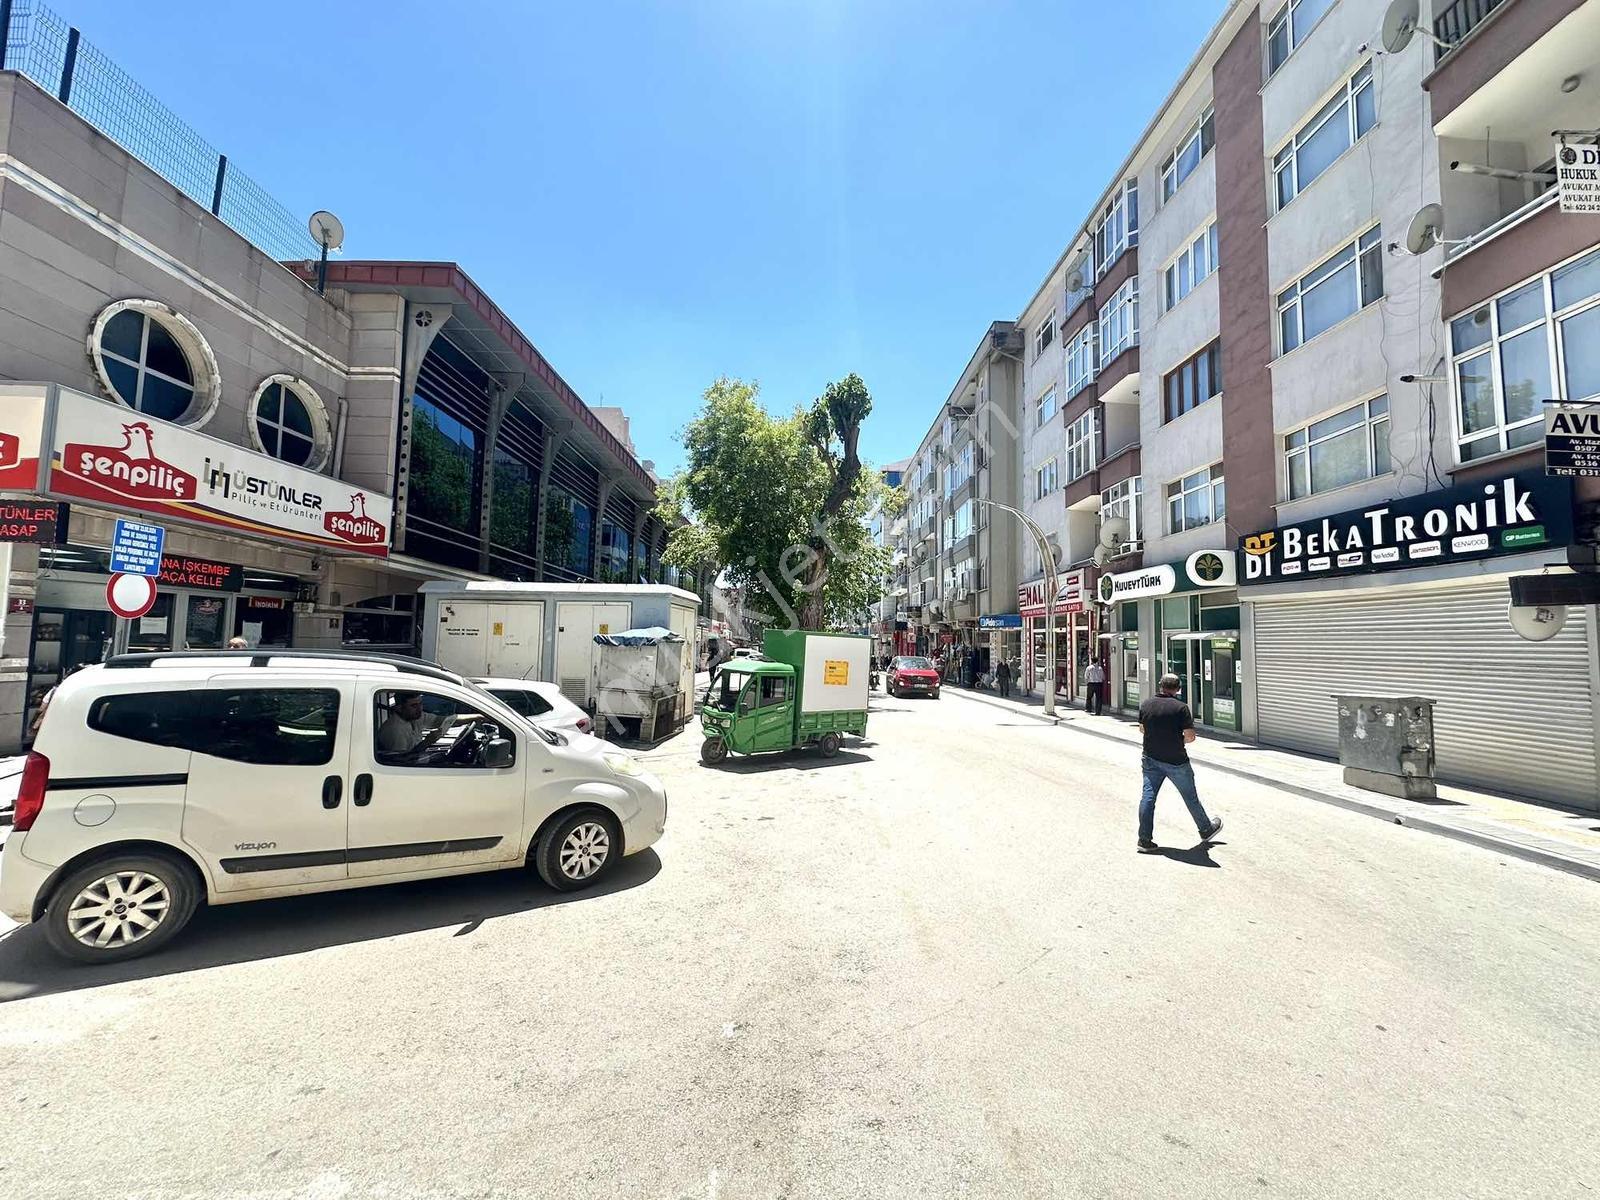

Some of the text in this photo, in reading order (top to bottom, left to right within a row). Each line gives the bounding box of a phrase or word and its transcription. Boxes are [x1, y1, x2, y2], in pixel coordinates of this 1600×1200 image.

[1582, 149, 1600, 165] D
[1560, 168, 1598, 180] HUKUK
[1561, 183, 1593, 191] AVUKAT
[1563, 194, 1593, 202] AVUKAT
[1555, 468, 1576, 476] Tel:
[233, 469, 323, 511] ÜSTÜNLER
[231, 492, 257, 508] Piliç
[269, 503, 280, 512] Et
[1453, 539, 1487, 548] KENWOOD
[182, 559, 231, 577] İŞKEMBE
[188, 574, 223, 587] KELLE
[234, 841, 277, 851] vizyon
